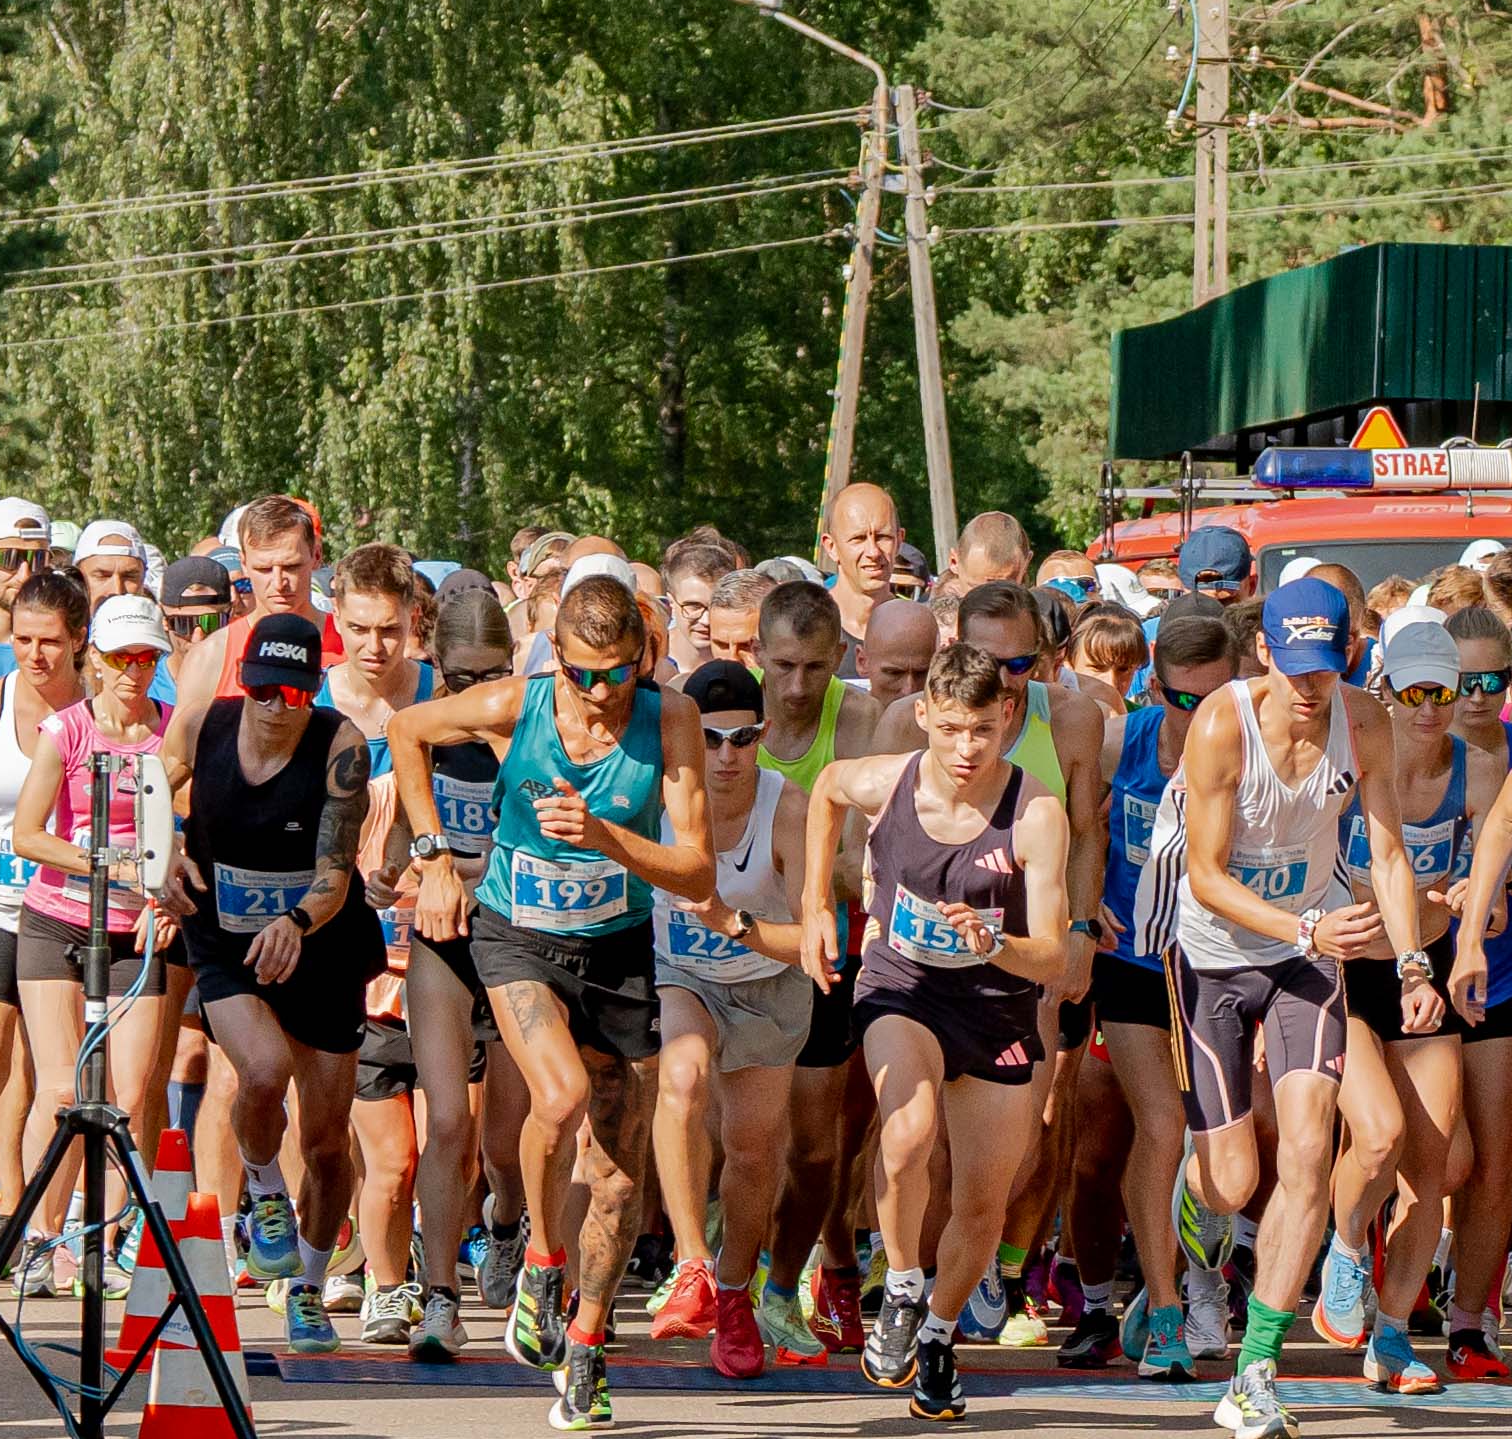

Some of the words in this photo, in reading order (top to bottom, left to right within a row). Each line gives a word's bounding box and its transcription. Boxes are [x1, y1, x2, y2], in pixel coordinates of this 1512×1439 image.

[259, 642, 307, 663] HOKA
[535, 879, 608, 909] 199
[1228, 866, 1290, 899] 40
[244, 888, 289, 914] 21
[686, 927, 744, 958] 22
